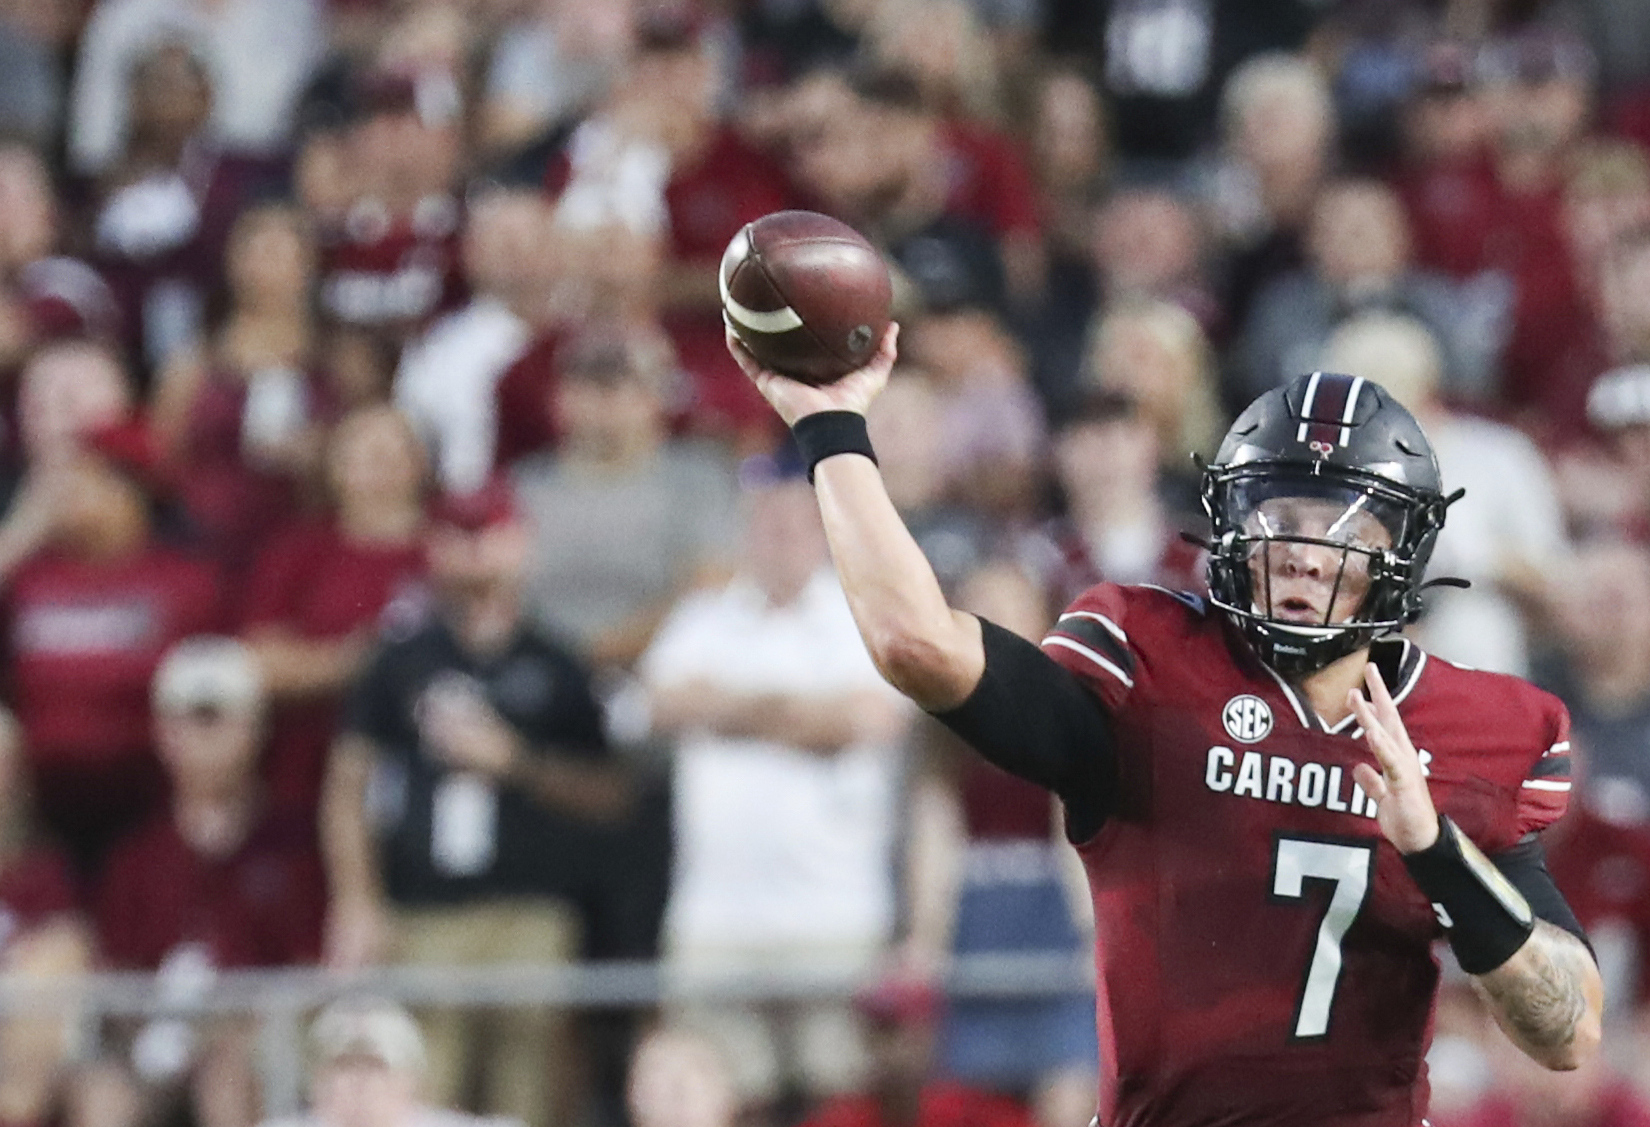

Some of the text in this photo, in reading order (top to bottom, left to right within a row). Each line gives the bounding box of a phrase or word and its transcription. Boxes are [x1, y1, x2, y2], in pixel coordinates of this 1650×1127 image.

[1227, 698, 1270, 740] SEC
[1205, 745, 1378, 819] CAROLI
[1272, 837, 1371, 1038] 7
